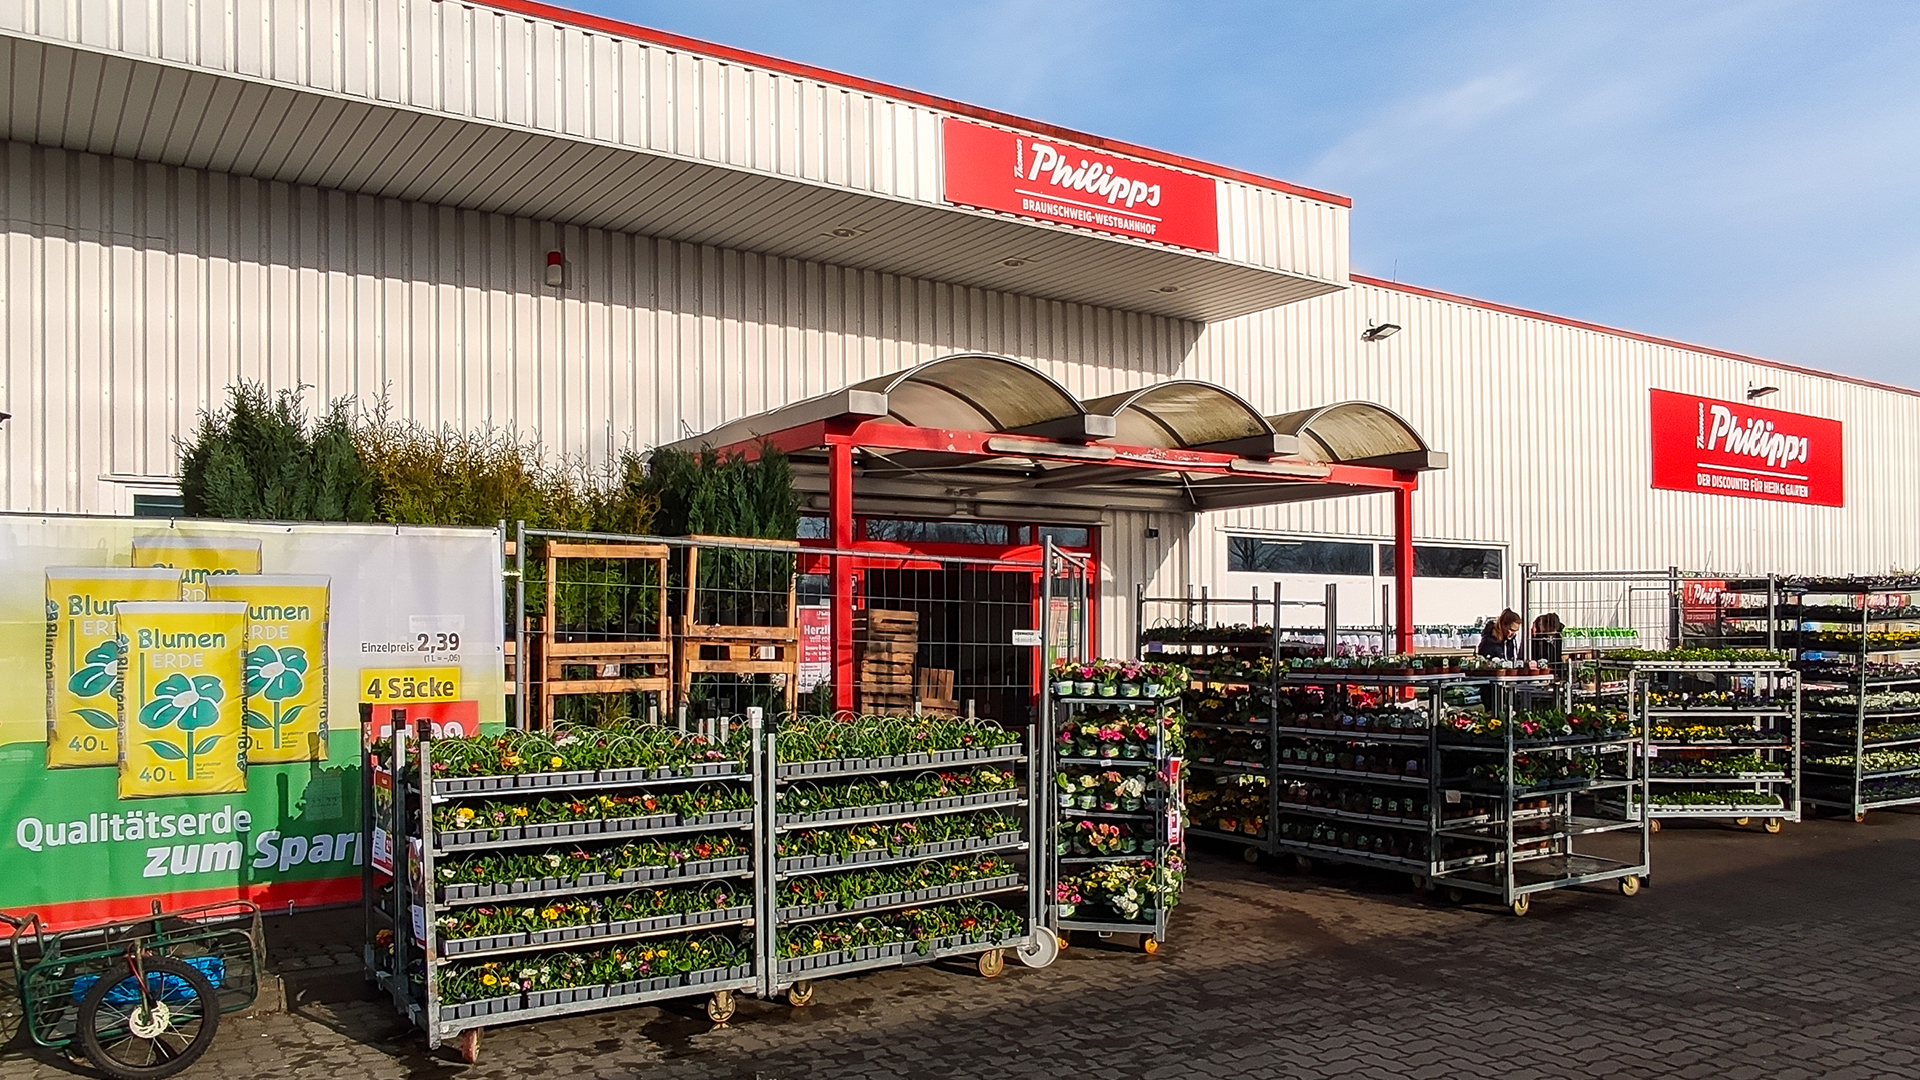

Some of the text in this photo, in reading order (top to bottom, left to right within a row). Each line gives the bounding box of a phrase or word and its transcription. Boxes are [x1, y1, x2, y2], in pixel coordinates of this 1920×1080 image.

[1028, 142, 1161, 208] Philipps
[1022, 198, 1157, 235] BRAUNSCHWEIG-WESTBAHNHOF
[1707, 404, 1808, 468] Philipps
[1697, 473, 1711, 486] DER
[1712, 475, 1750, 491] DISCOUNTER
[1750, 478, 1763, 492] FÜR
[138, 628, 226, 649] Blumen
[361, 632, 460, 654] Einzelpreis 2,39
[152, 652, 204, 668] ERDE
[367, 676, 455, 699] 4 Säcke
[69, 736, 109, 752] 40 L
[139, 766, 177, 783] 40 L
[16, 804, 252, 852] Qualitätserde
[143, 841, 244, 878] zum
